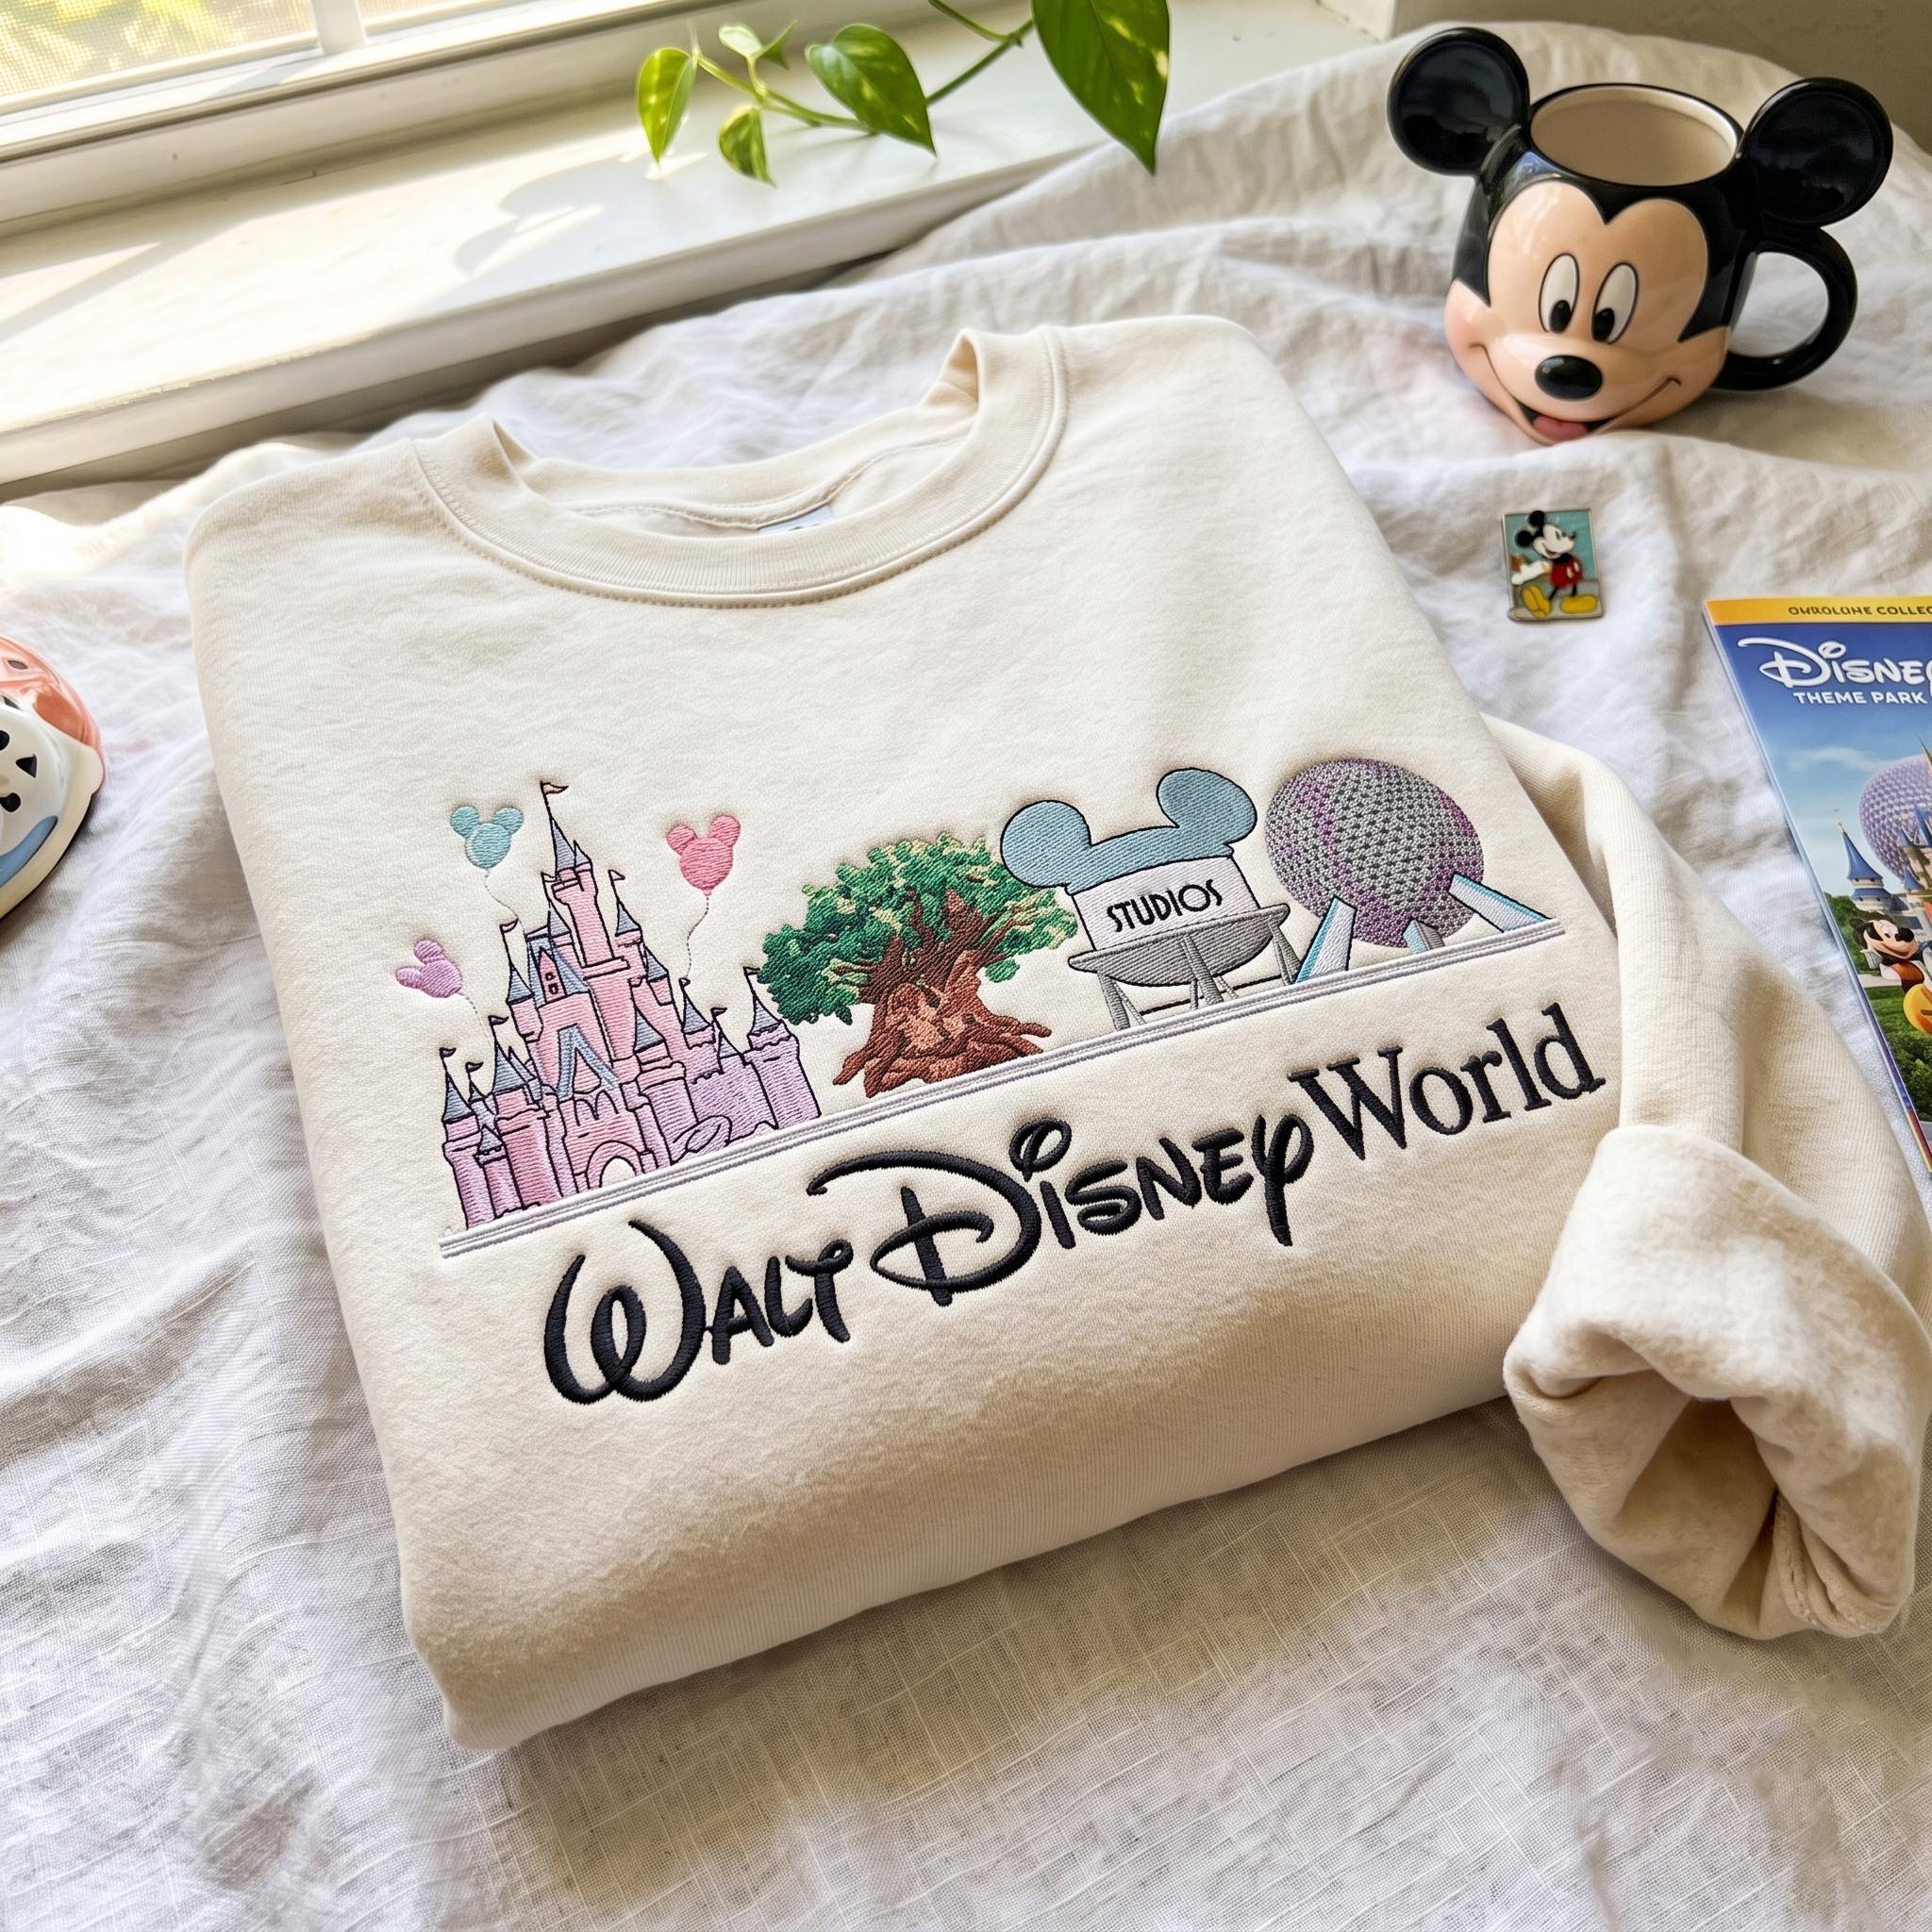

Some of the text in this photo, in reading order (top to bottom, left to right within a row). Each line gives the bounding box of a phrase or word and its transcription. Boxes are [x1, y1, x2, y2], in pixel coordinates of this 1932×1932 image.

[1793, 691, 1928, 705] THEME PARK
[1107, 878, 1224, 933] STUDIOS
[1285, 1001, 1607, 1161] World
